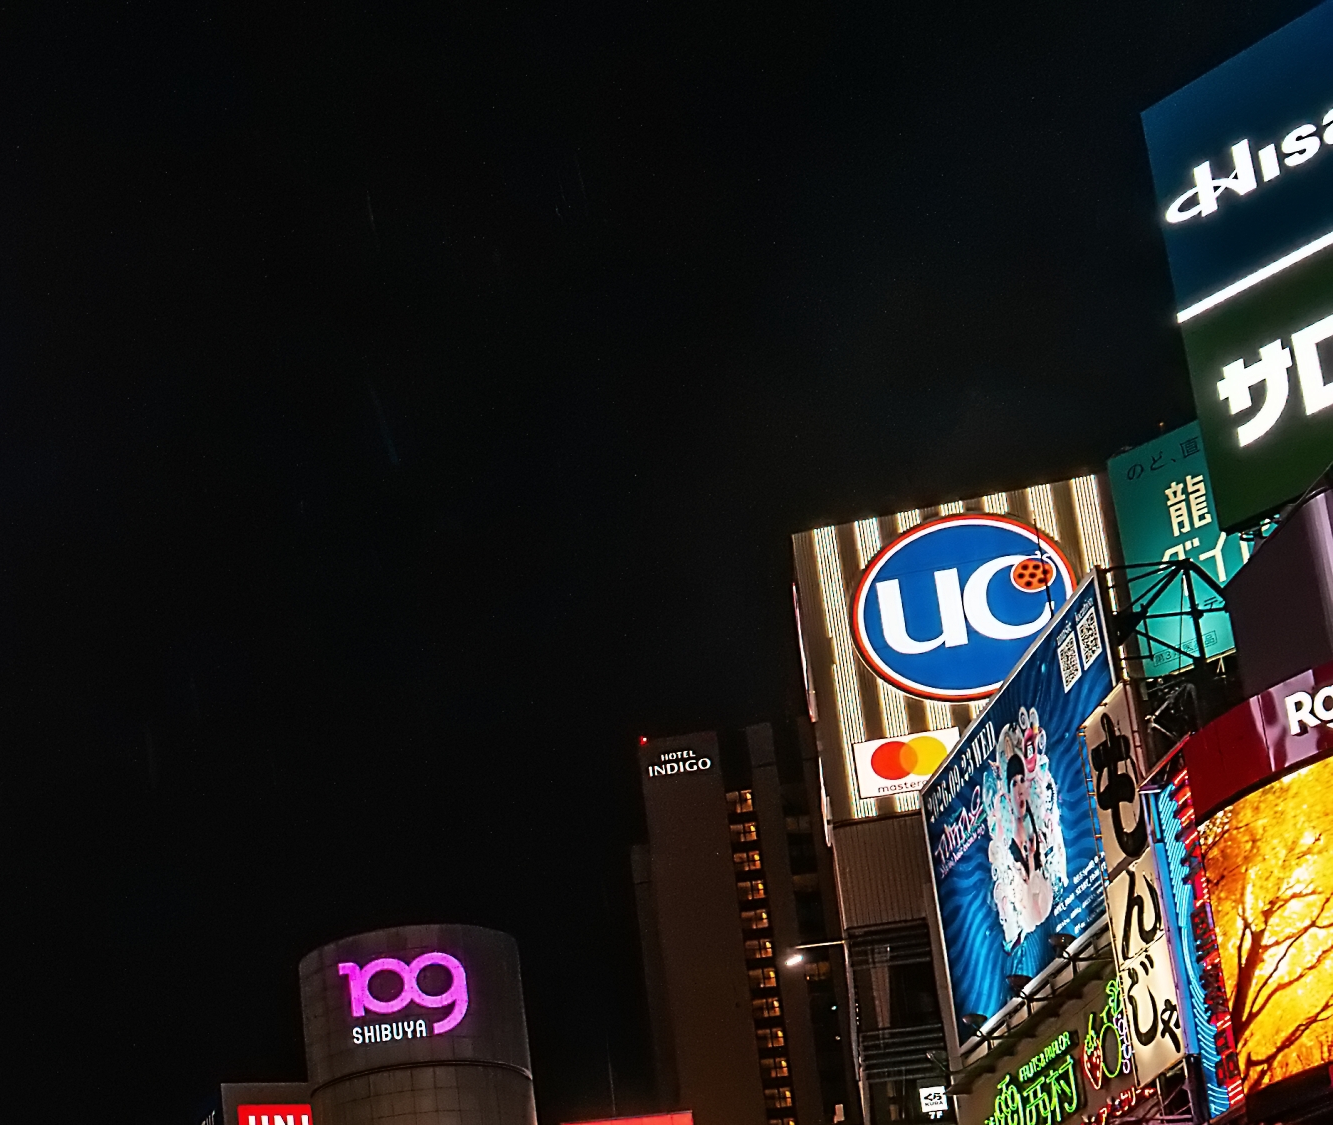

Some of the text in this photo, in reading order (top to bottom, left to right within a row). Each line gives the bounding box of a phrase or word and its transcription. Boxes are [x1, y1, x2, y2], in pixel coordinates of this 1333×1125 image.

[661, 749, 696, 761] HOTEL
[971, 721, 997, 768] WED
[648, 757, 712, 778] INDIGO
[1091, 712, 1182, 1054] もんじゃ
[338, 952, 469, 1035] 109
[352, 1019, 427, 1044] SHIBUYA
